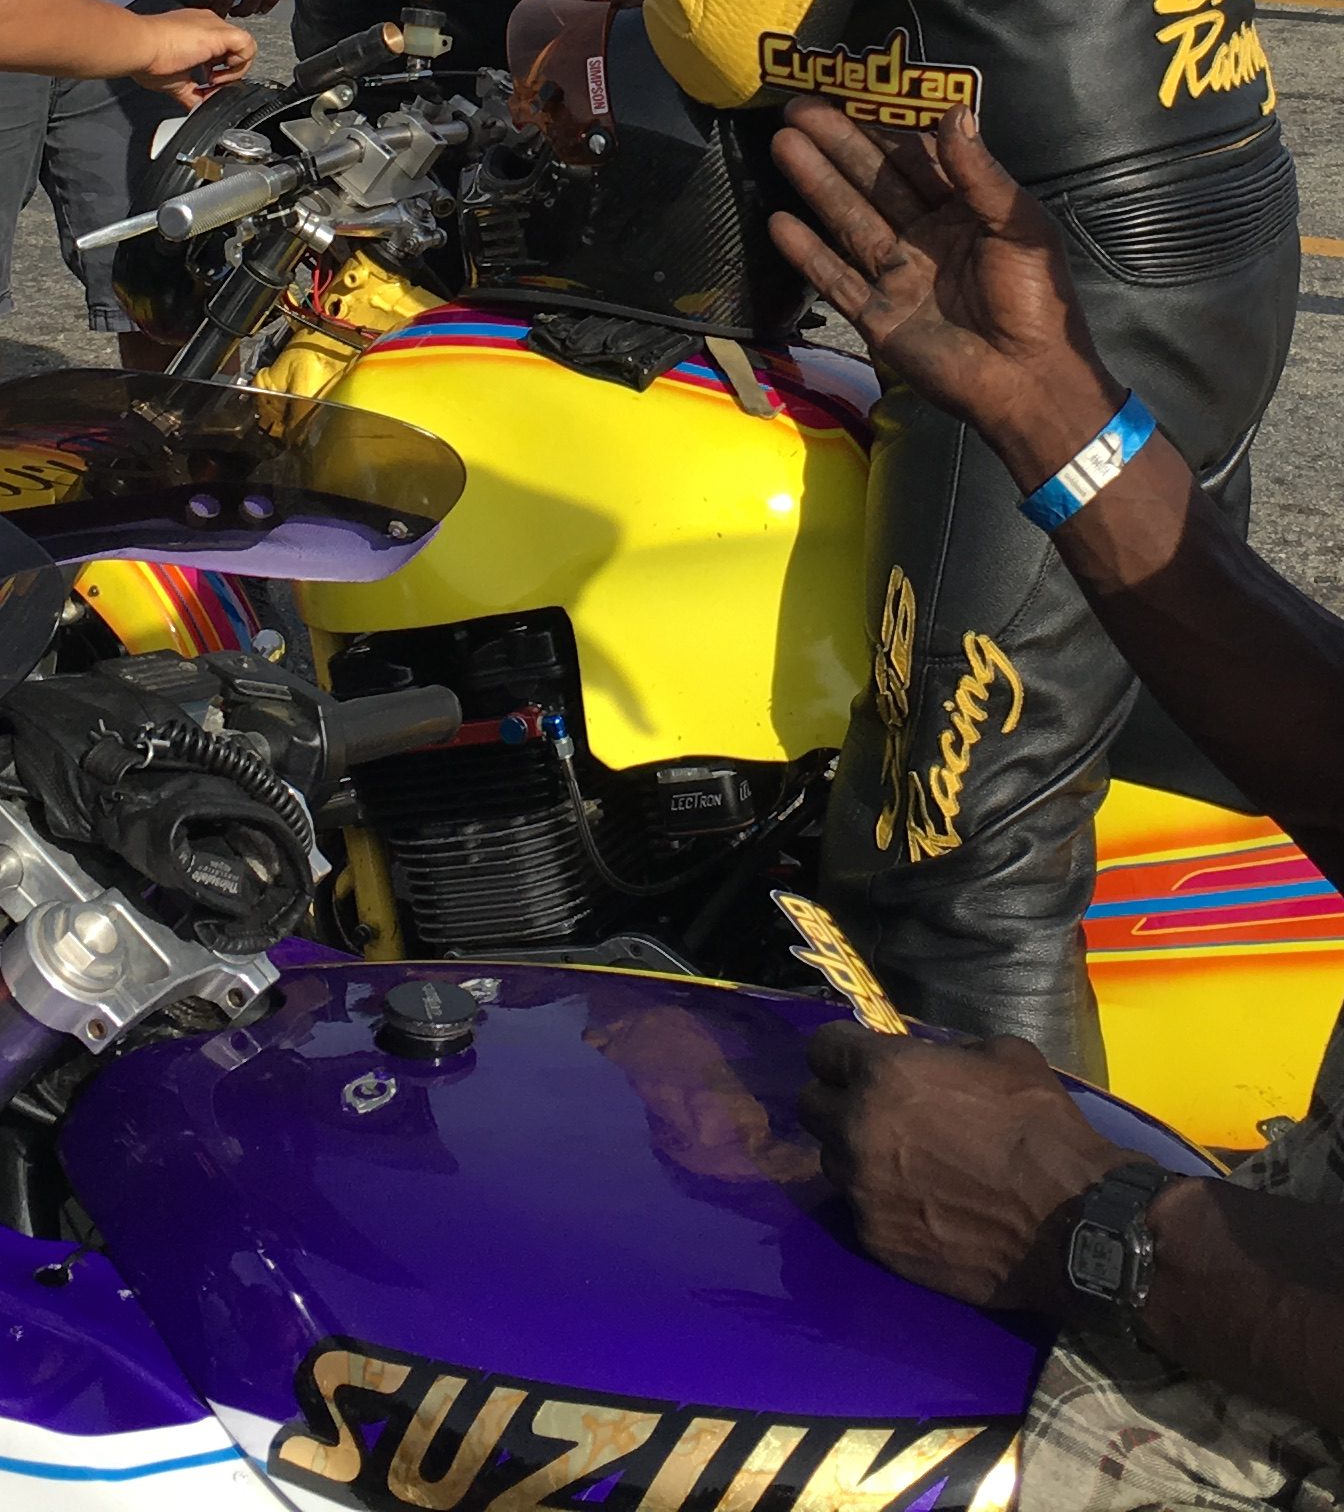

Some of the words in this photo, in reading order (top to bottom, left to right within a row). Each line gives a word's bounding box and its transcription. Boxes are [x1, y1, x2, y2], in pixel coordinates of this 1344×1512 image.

[588, 59, 606, 110] SIMPSON
[906, 630, 1025, 864] Racing
[670, 791, 723, 811] LECTRON
[191, 870, 239, 894] Thinsulate
